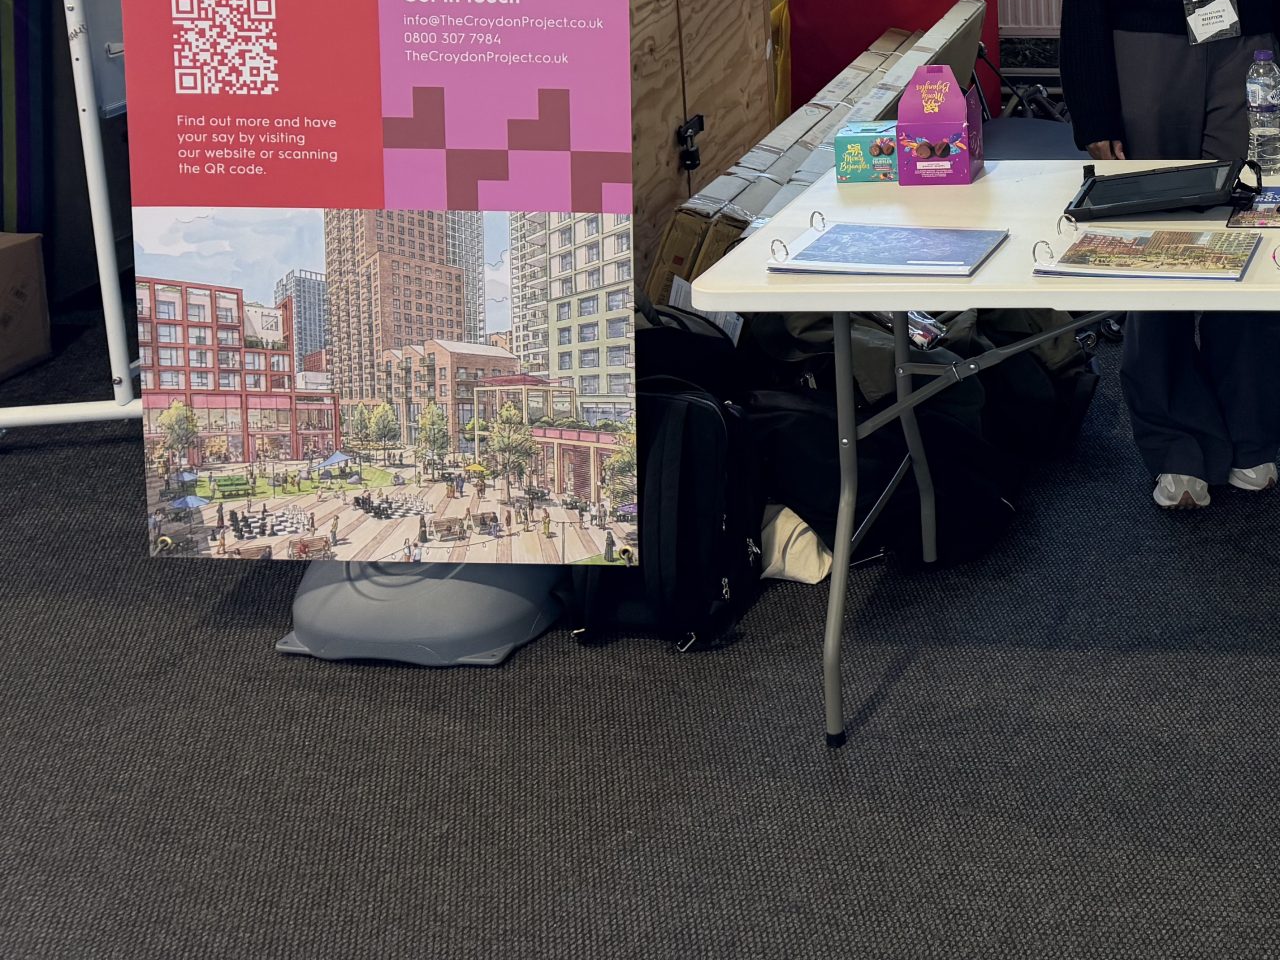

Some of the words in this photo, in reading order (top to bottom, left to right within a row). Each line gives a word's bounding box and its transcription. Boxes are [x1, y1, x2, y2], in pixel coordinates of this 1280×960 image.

[404, 15, 603, 30] info@TheCroydonProject.co.uk
[404, 32, 436, 43] 0800
[442, 33, 465, 43] 307
[469, 34, 501, 44] 7984
[405, 50, 568, 65] TheCroydonProject.co.uk
[177, 115, 205, 126] Find
[210, 116, 231, 126] out
[236, 118, 270, 126] more
[274, 117, 299, 127] and
[305, 117, 336, 127] have
[178, 134, 207, 144] your
[212, 134, 234, 144] say
[239, 132, 255, 145] by
[259, 133, 305, 146] visiting
[205, 148, 255, 158] website
[260, 150, 274, 158] or
[279, 149, 337, 162] scanning
[179, 163, 200, 173] the
[205, 163, 225, 174] QR
[230, 164, 266, 174] code.
